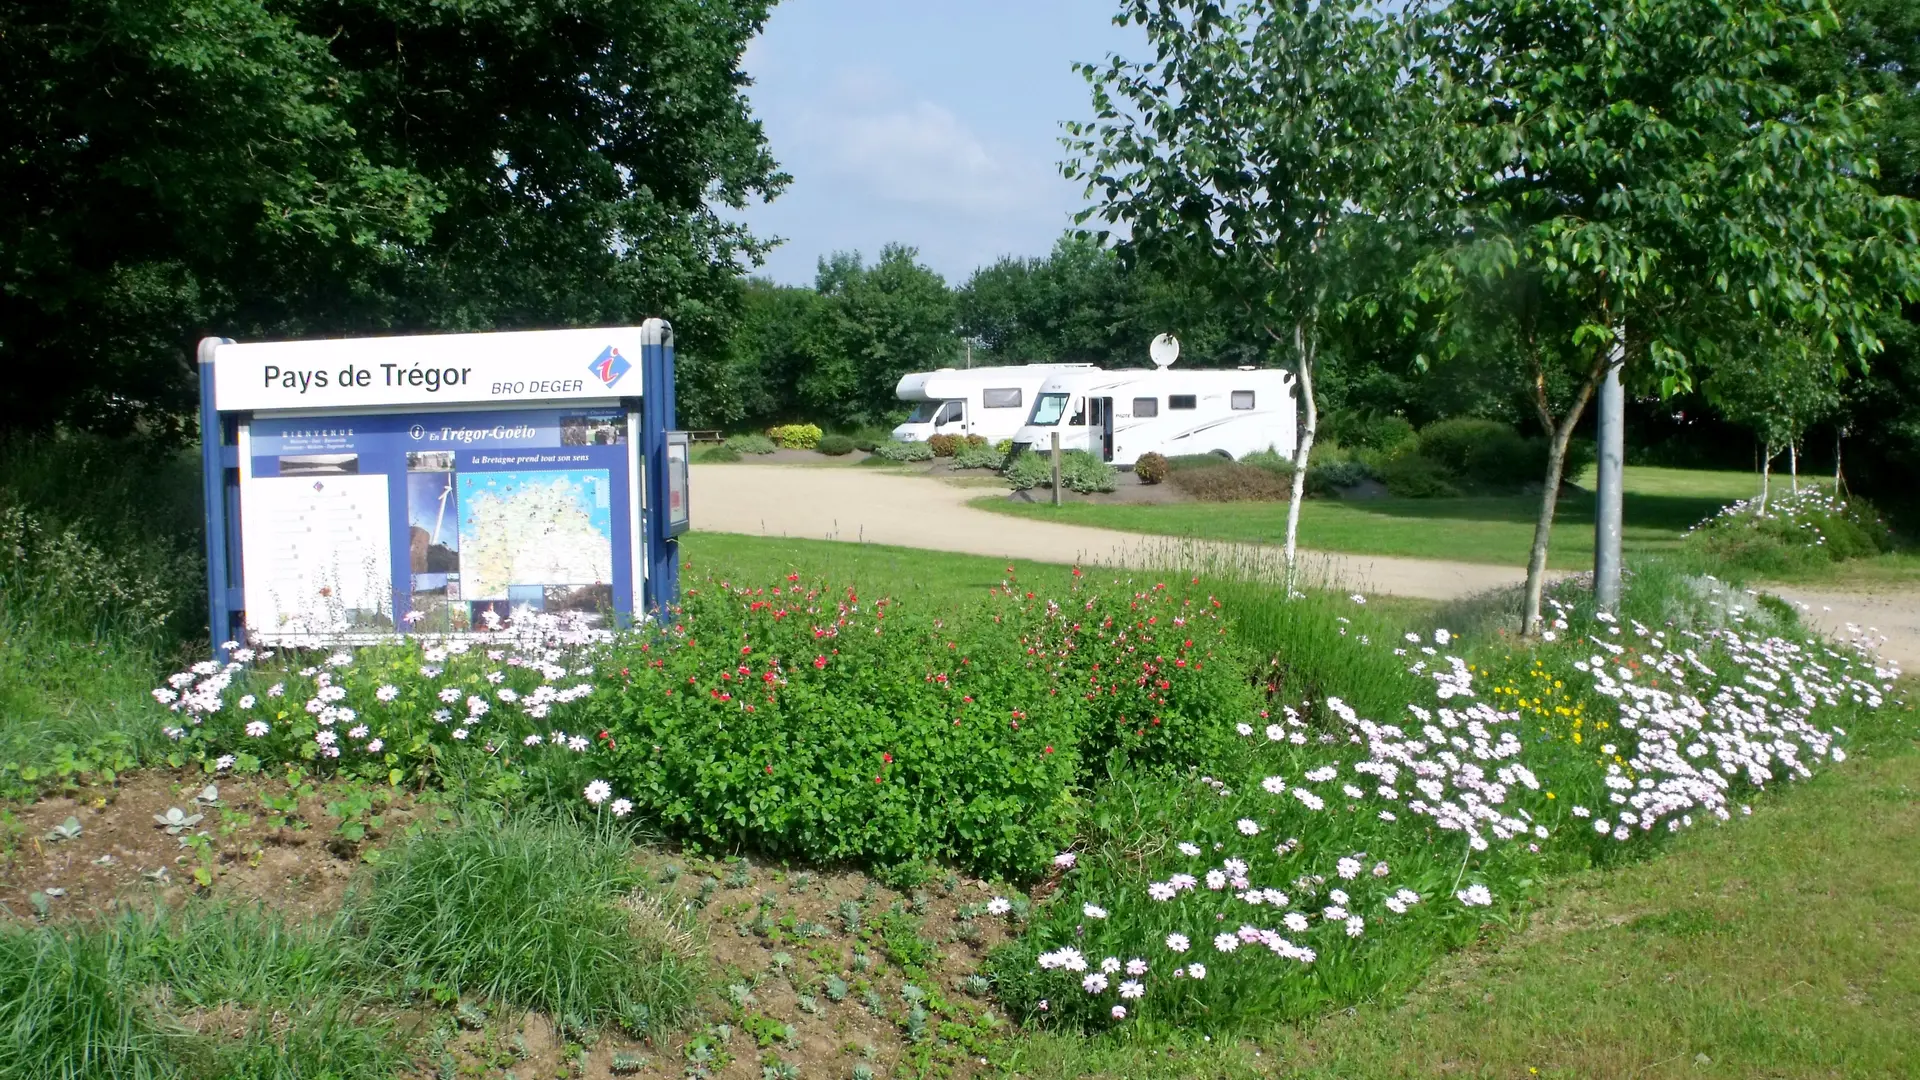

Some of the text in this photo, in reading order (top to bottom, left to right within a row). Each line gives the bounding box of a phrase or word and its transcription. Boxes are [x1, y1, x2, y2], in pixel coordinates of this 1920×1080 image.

[265, 362, 472, 394] Pays de Trégor
[491, 379, 583, 394] BRO DEGER
[282, 429, 354, 438] BIENVENUE
[429, 433, 439, 441] En
[441, 425, 536, 443] Trégor-Goëlo
[472, 456, 480, 464] la
[482, 455, 515, 465] Bretagne
[516, 454, 540, 464] prend
